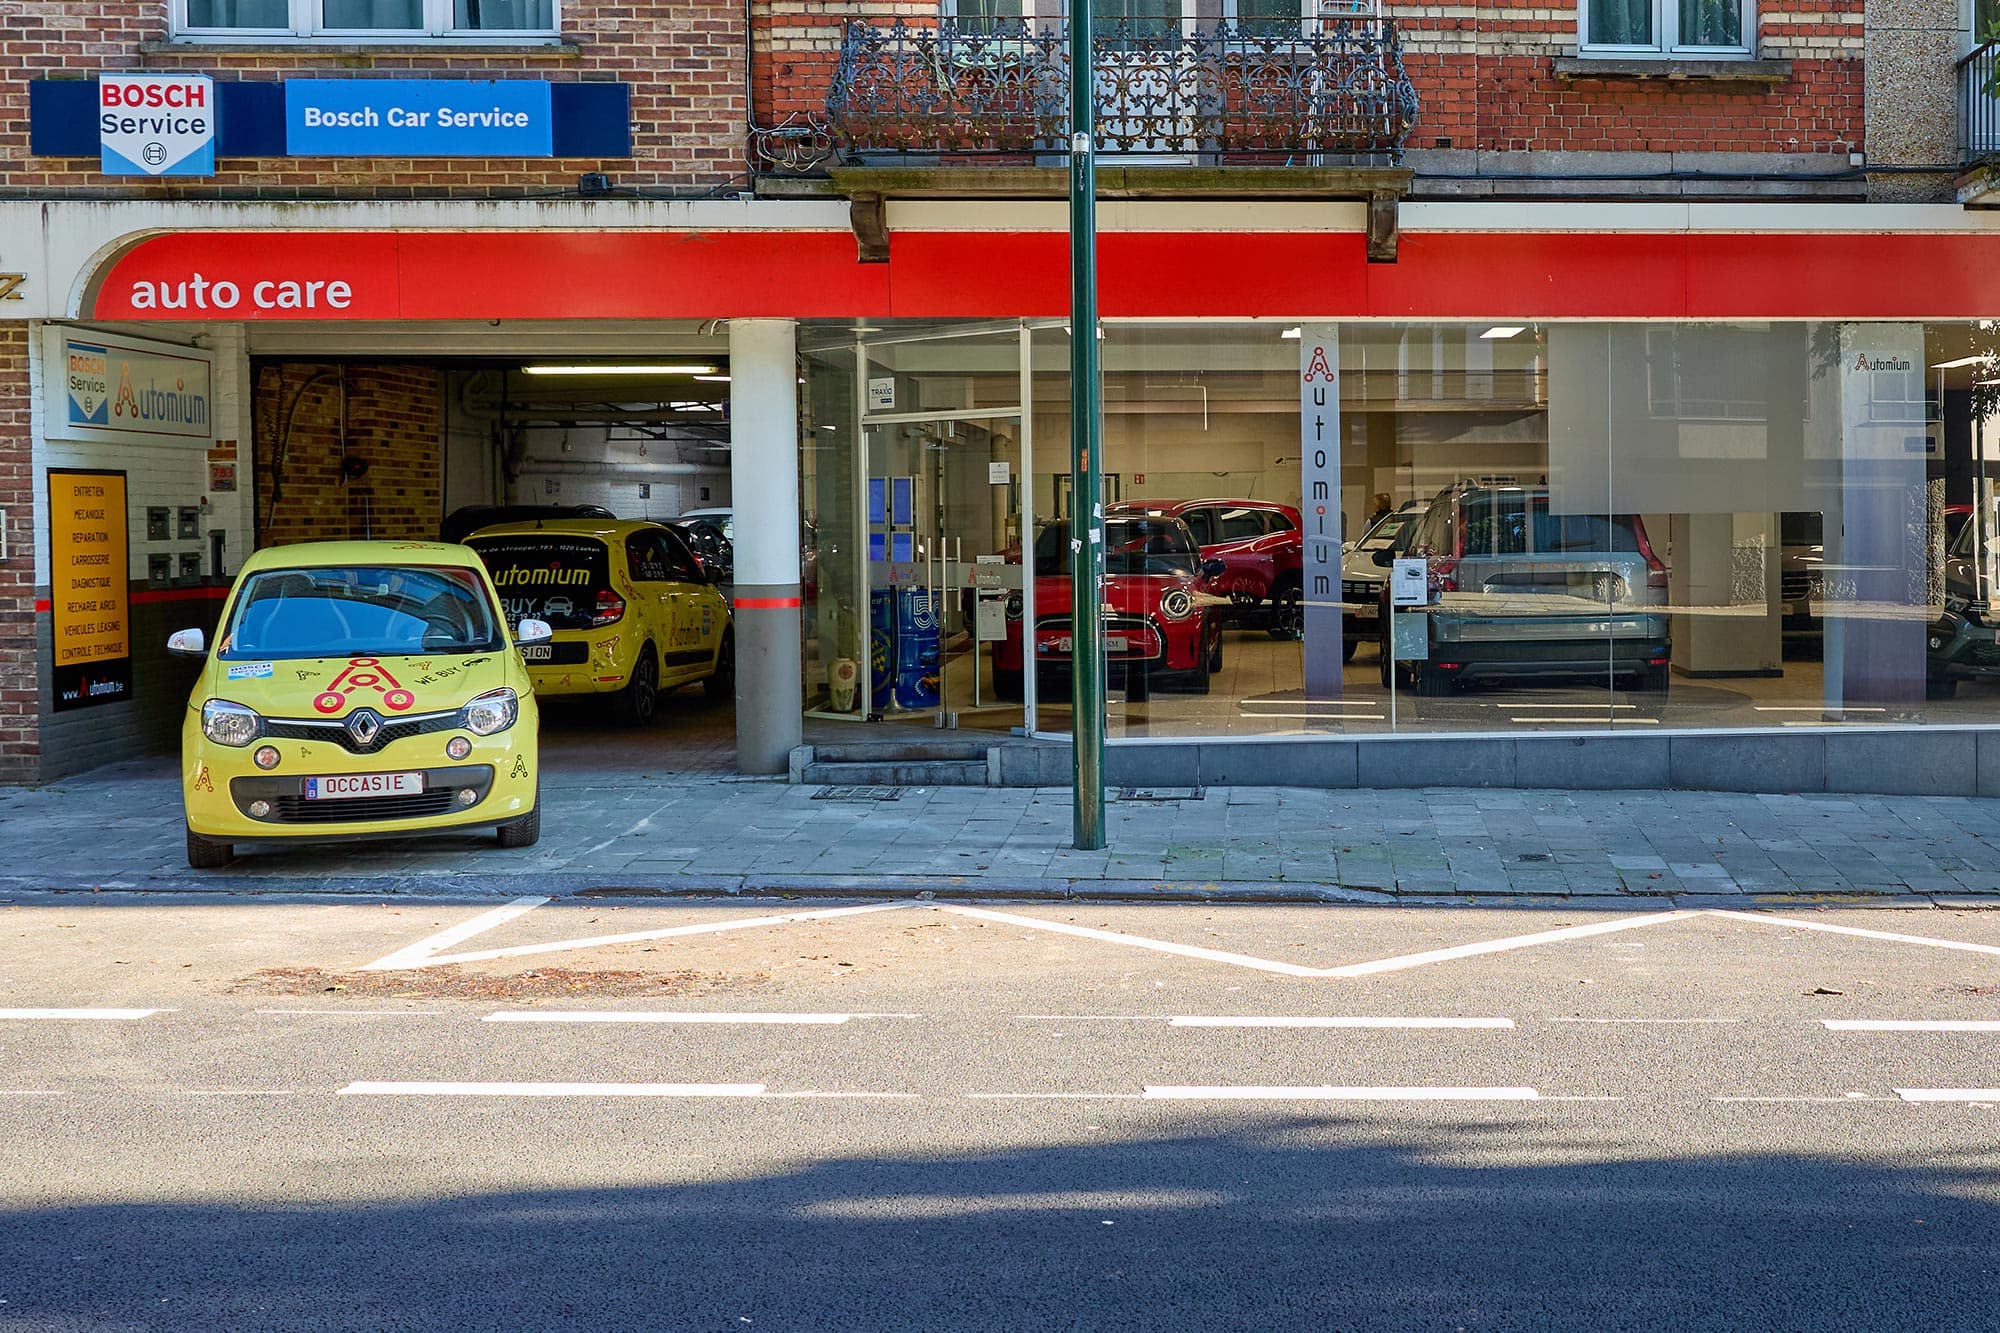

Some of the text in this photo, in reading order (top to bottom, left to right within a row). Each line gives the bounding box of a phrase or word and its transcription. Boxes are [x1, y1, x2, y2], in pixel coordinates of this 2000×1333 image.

[101, 83, 206, 109] BOSCH
[100, 113, 206, 136] Service
[304, 106, 529, 128] Bosch Car Service
[131, 273, 352, 310] auto care
[70, 355, 105, 375] BOSCH
[1855, 352, 1910, 371] Automium
[70, 376, 106, 393] Service
[114, 361, 205, 425] Automium
[1304, 346, 1335, 595] Automium
[74, 486, 104, 497] ENTRETIEN
[74, 509, 105, 520] MECANIQUE
[72, 532, 109, 544] REPARATION
[72, 554, 110, 566] CARROSSERIE
[492, 560, 591, 587] utomium
[71, 577, 111, 589] DIAGNOSTIQUE
[67, 600, 116, 613] RECHARGE AIRCO
[64, 620, 121, 636] VEHICULES LEASING
[62, 642, 123, 660] CONTROLE TECHNIQUE
[521, 647, 550, 658] SION
[414, 666, 461, 685] WE BUY
[326, 775, 404, 793] OCCASIE
